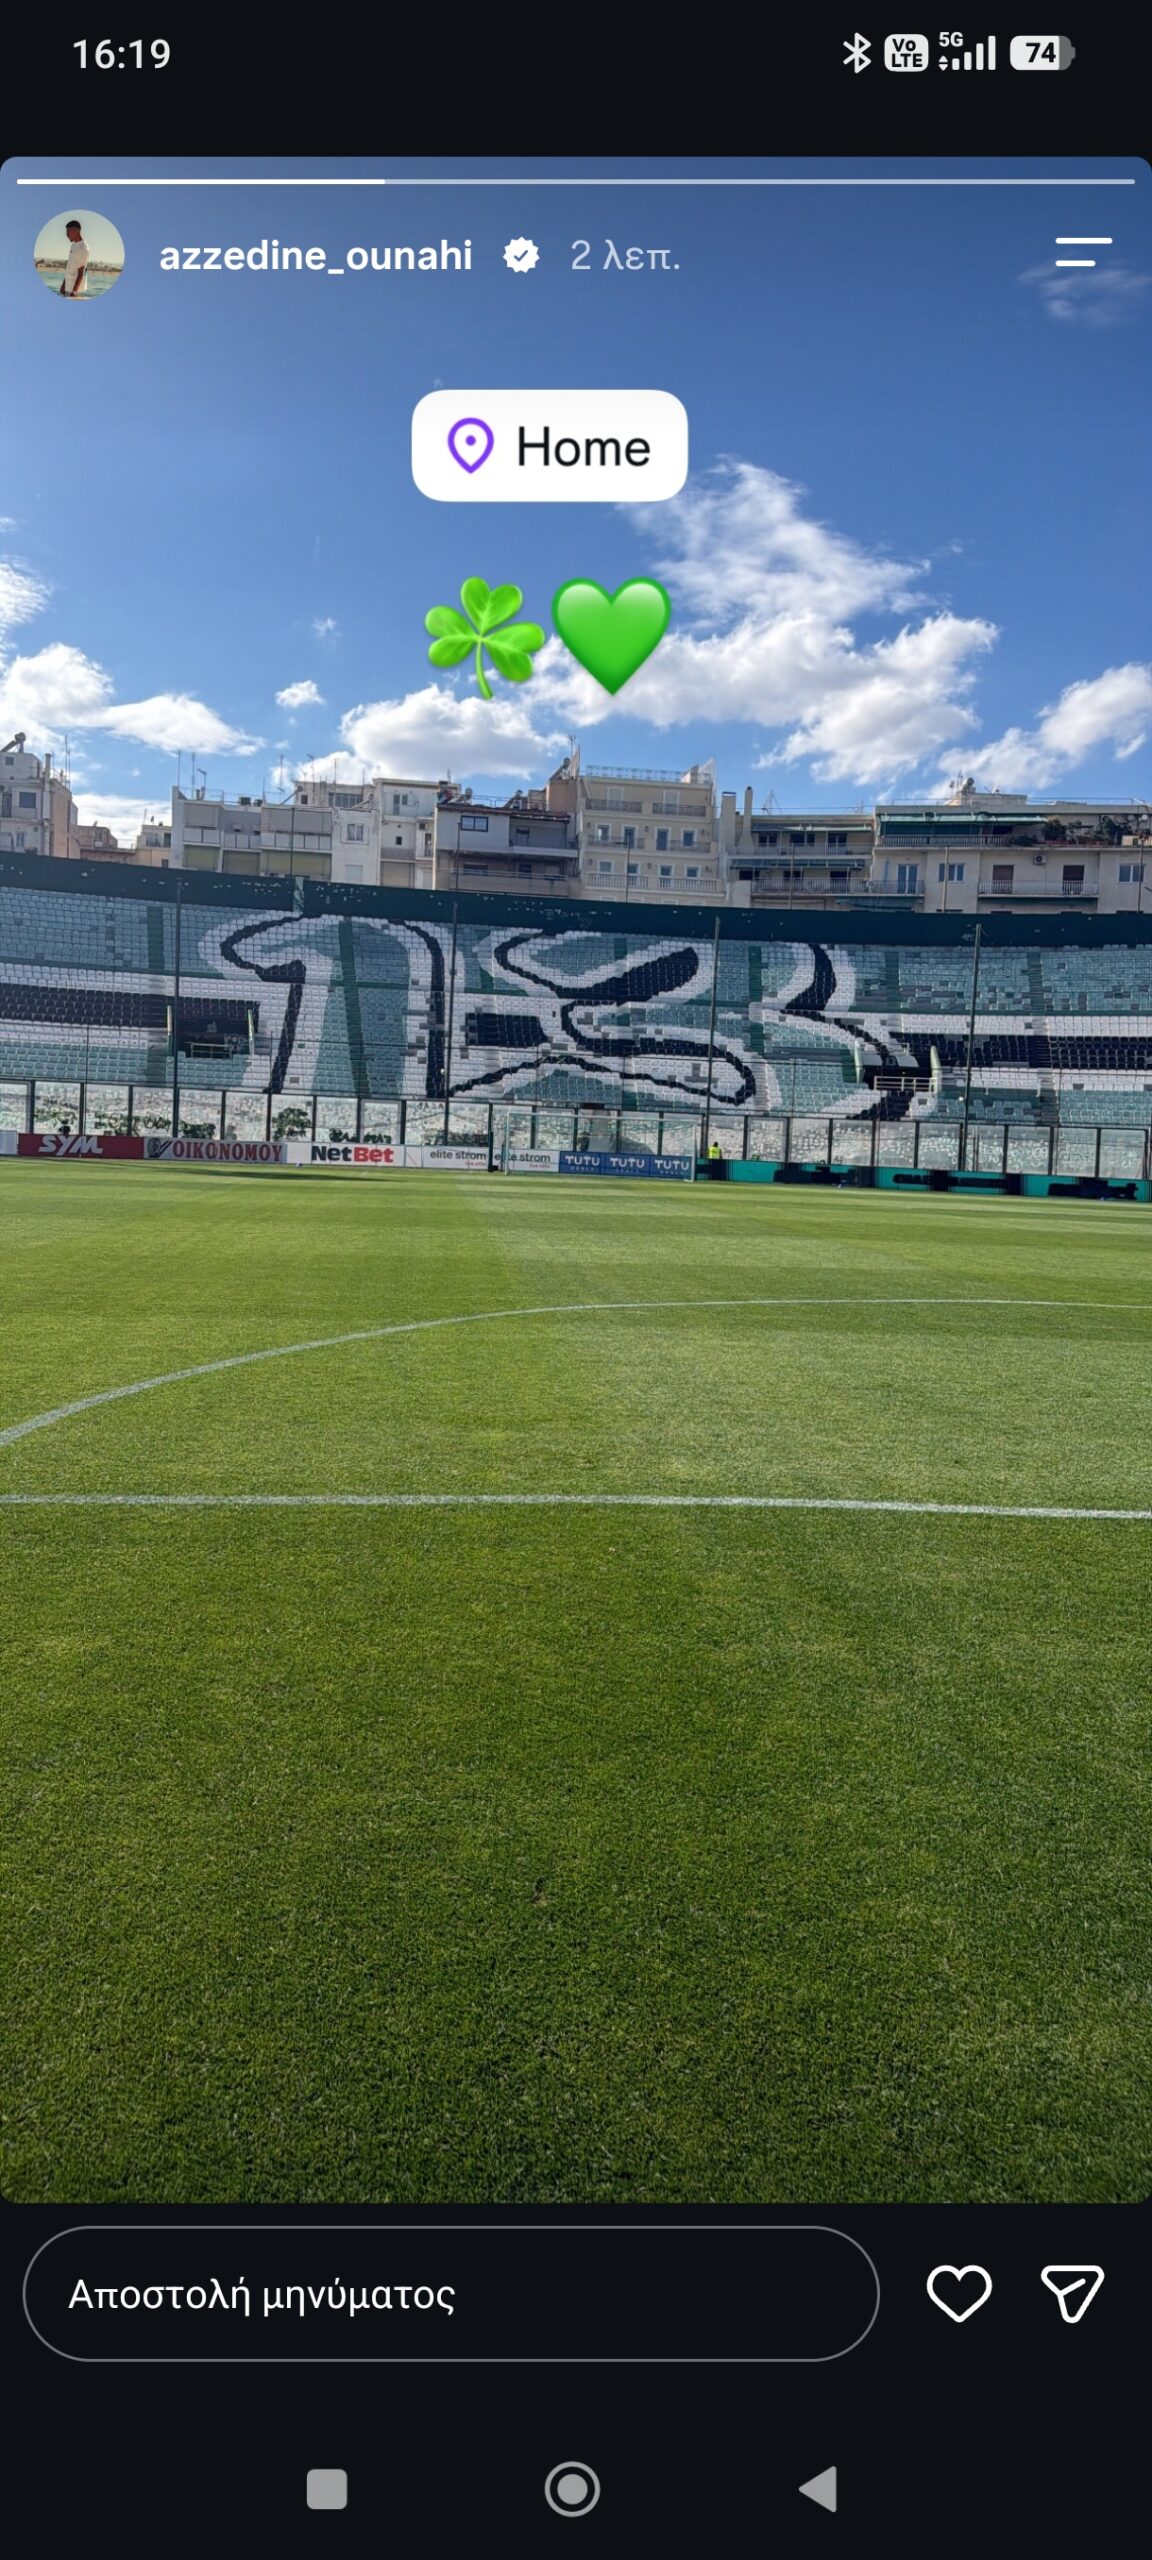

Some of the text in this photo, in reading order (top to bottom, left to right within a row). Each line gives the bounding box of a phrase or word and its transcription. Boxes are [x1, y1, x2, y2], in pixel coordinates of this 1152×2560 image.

[38, 1135, 103, 1156] SYM
[311, 1145, 394, 1163] NetBet
[430, 1149, 487, 1160] elite strom
[519, 1152, 551, 1162] strom
[565, 1155, 600, 1166] TUTU
[610, 1157, 645, 1168] TUTU
[655, 1159, 690, 1170] TUTU
